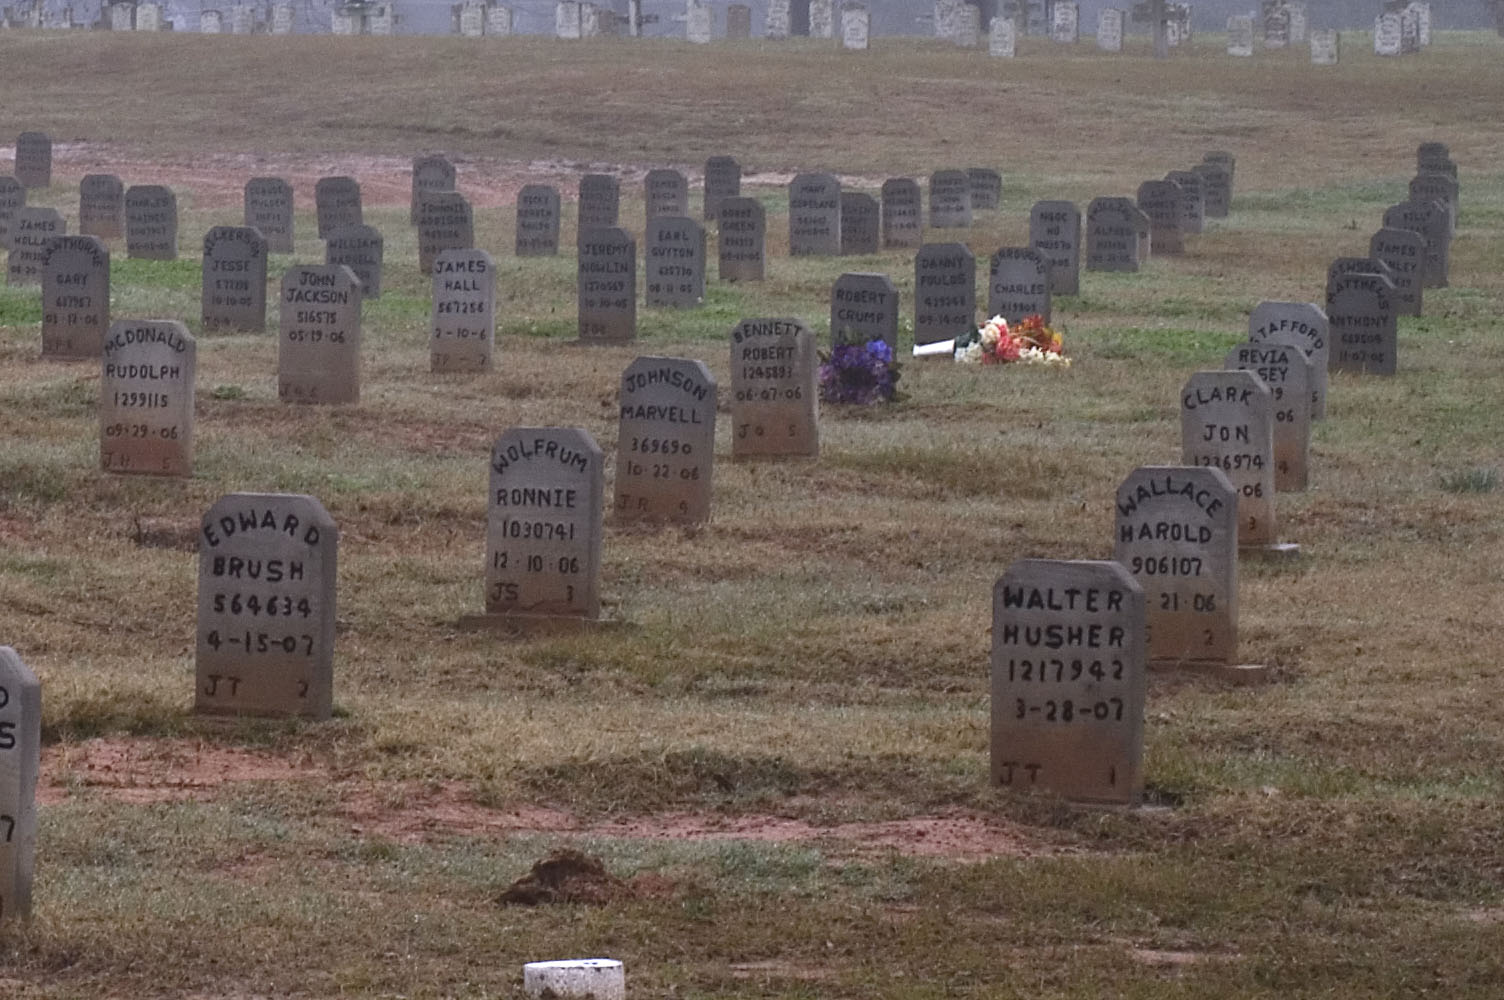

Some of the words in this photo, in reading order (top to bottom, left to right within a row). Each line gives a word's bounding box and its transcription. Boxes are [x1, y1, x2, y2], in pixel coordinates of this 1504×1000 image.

[19, 220, 56, 233] JAMES
[657, 229, 688, 242] EARL
[203, 228, 263, 259] WILKERSON
[327, 238, 378, 251] WILLIAM
[583, 243, 629, 257] JEREMY
[650, 246, 694, 259] GUYTON
[213, 260, 250, 274] JESSE
[435, 260, 487, 275] JAMES
[581, 261, 629, 275] NOWLIN
[921, 257, 965, 271] DANNY
[55, 273, 88, 287] GARY
[300, 270, 336, 288] JOHN
[444, 279, 480, 292] HALL
[286, 287, 348, 305] JACKSON
[835, 288, 887, 306] ROBERT
[994, 284, 1045, 296] CHARLES
[437, 301, 485, 315] 567256
[837, 309, 886, 325] CRUMP
[297, 311, 337, 325] 516575
[1328, 315, 1389, 329] ANTHONY
[733, 320, 803, 345] BENNETT
[1249, 319, 1324, 350] TAFFORD
[103, 328, 187, 358] MCDONALD
[741, 347, 795, 362] ROBERT
[1238, 349, 1290, 366] REVIA
[106, 363, 180, 379] RUDOLPH
[625, 369, 707, 401] JOHNSON
[114, 391, 169, 409] 1299115
[1183, 386, 1254, 411] CLARK
[620, 404, 703, 425] MARVELL
[1202, 424, 1250, 444] JON
[631, 438, 693, 456] 369690
[492, 438, 588, 475] WOLFRUM
[496, 488, 577, 509] RONNIE
[1117, 475, 1225, 519] WALLACE
[203, 508, 320, 547] EDWARD
[501, 519, 576, 541] 1030741
[1119, 521, 1213, 544] HAROLD
[212, 556, 305, 581] BRUSH
[1131, 556, 1204, 578] 906107
[213, 593, 312, 617] 564634
[1003, 587, 1124, 612] WALTER
[1003, 625, 1126, 650] HUSHER
[1008, 659, 1124, 682] 1217942
[204, 674, 242, 696] JT
[999, 760, 1043, 786] JT
